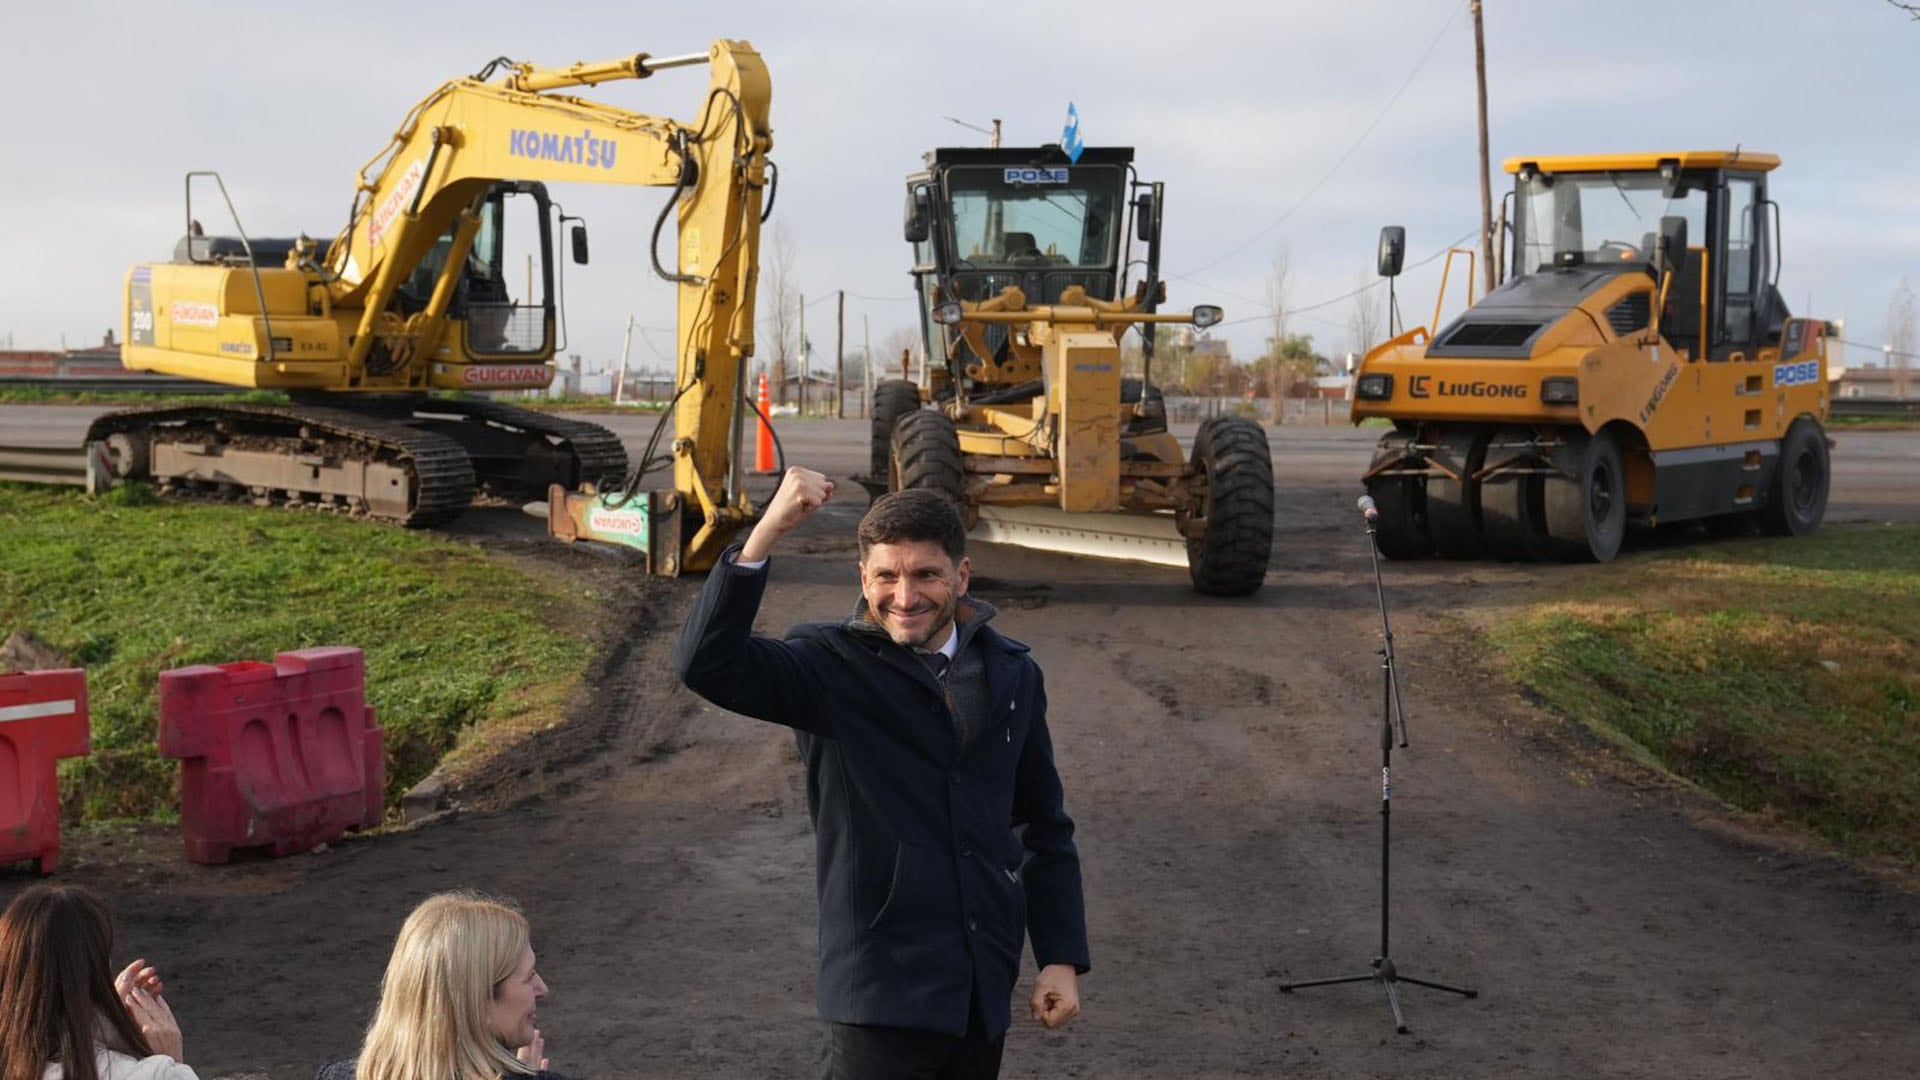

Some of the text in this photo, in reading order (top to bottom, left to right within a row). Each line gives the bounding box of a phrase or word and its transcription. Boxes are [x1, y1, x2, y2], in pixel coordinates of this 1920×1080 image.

[1006, 170, 1067, 181] POSE
[132, 310, 153, 331] 200
[463, 366, 546, 383] GUIGIVAN
[1774, 362, 1818, 384] POSE
